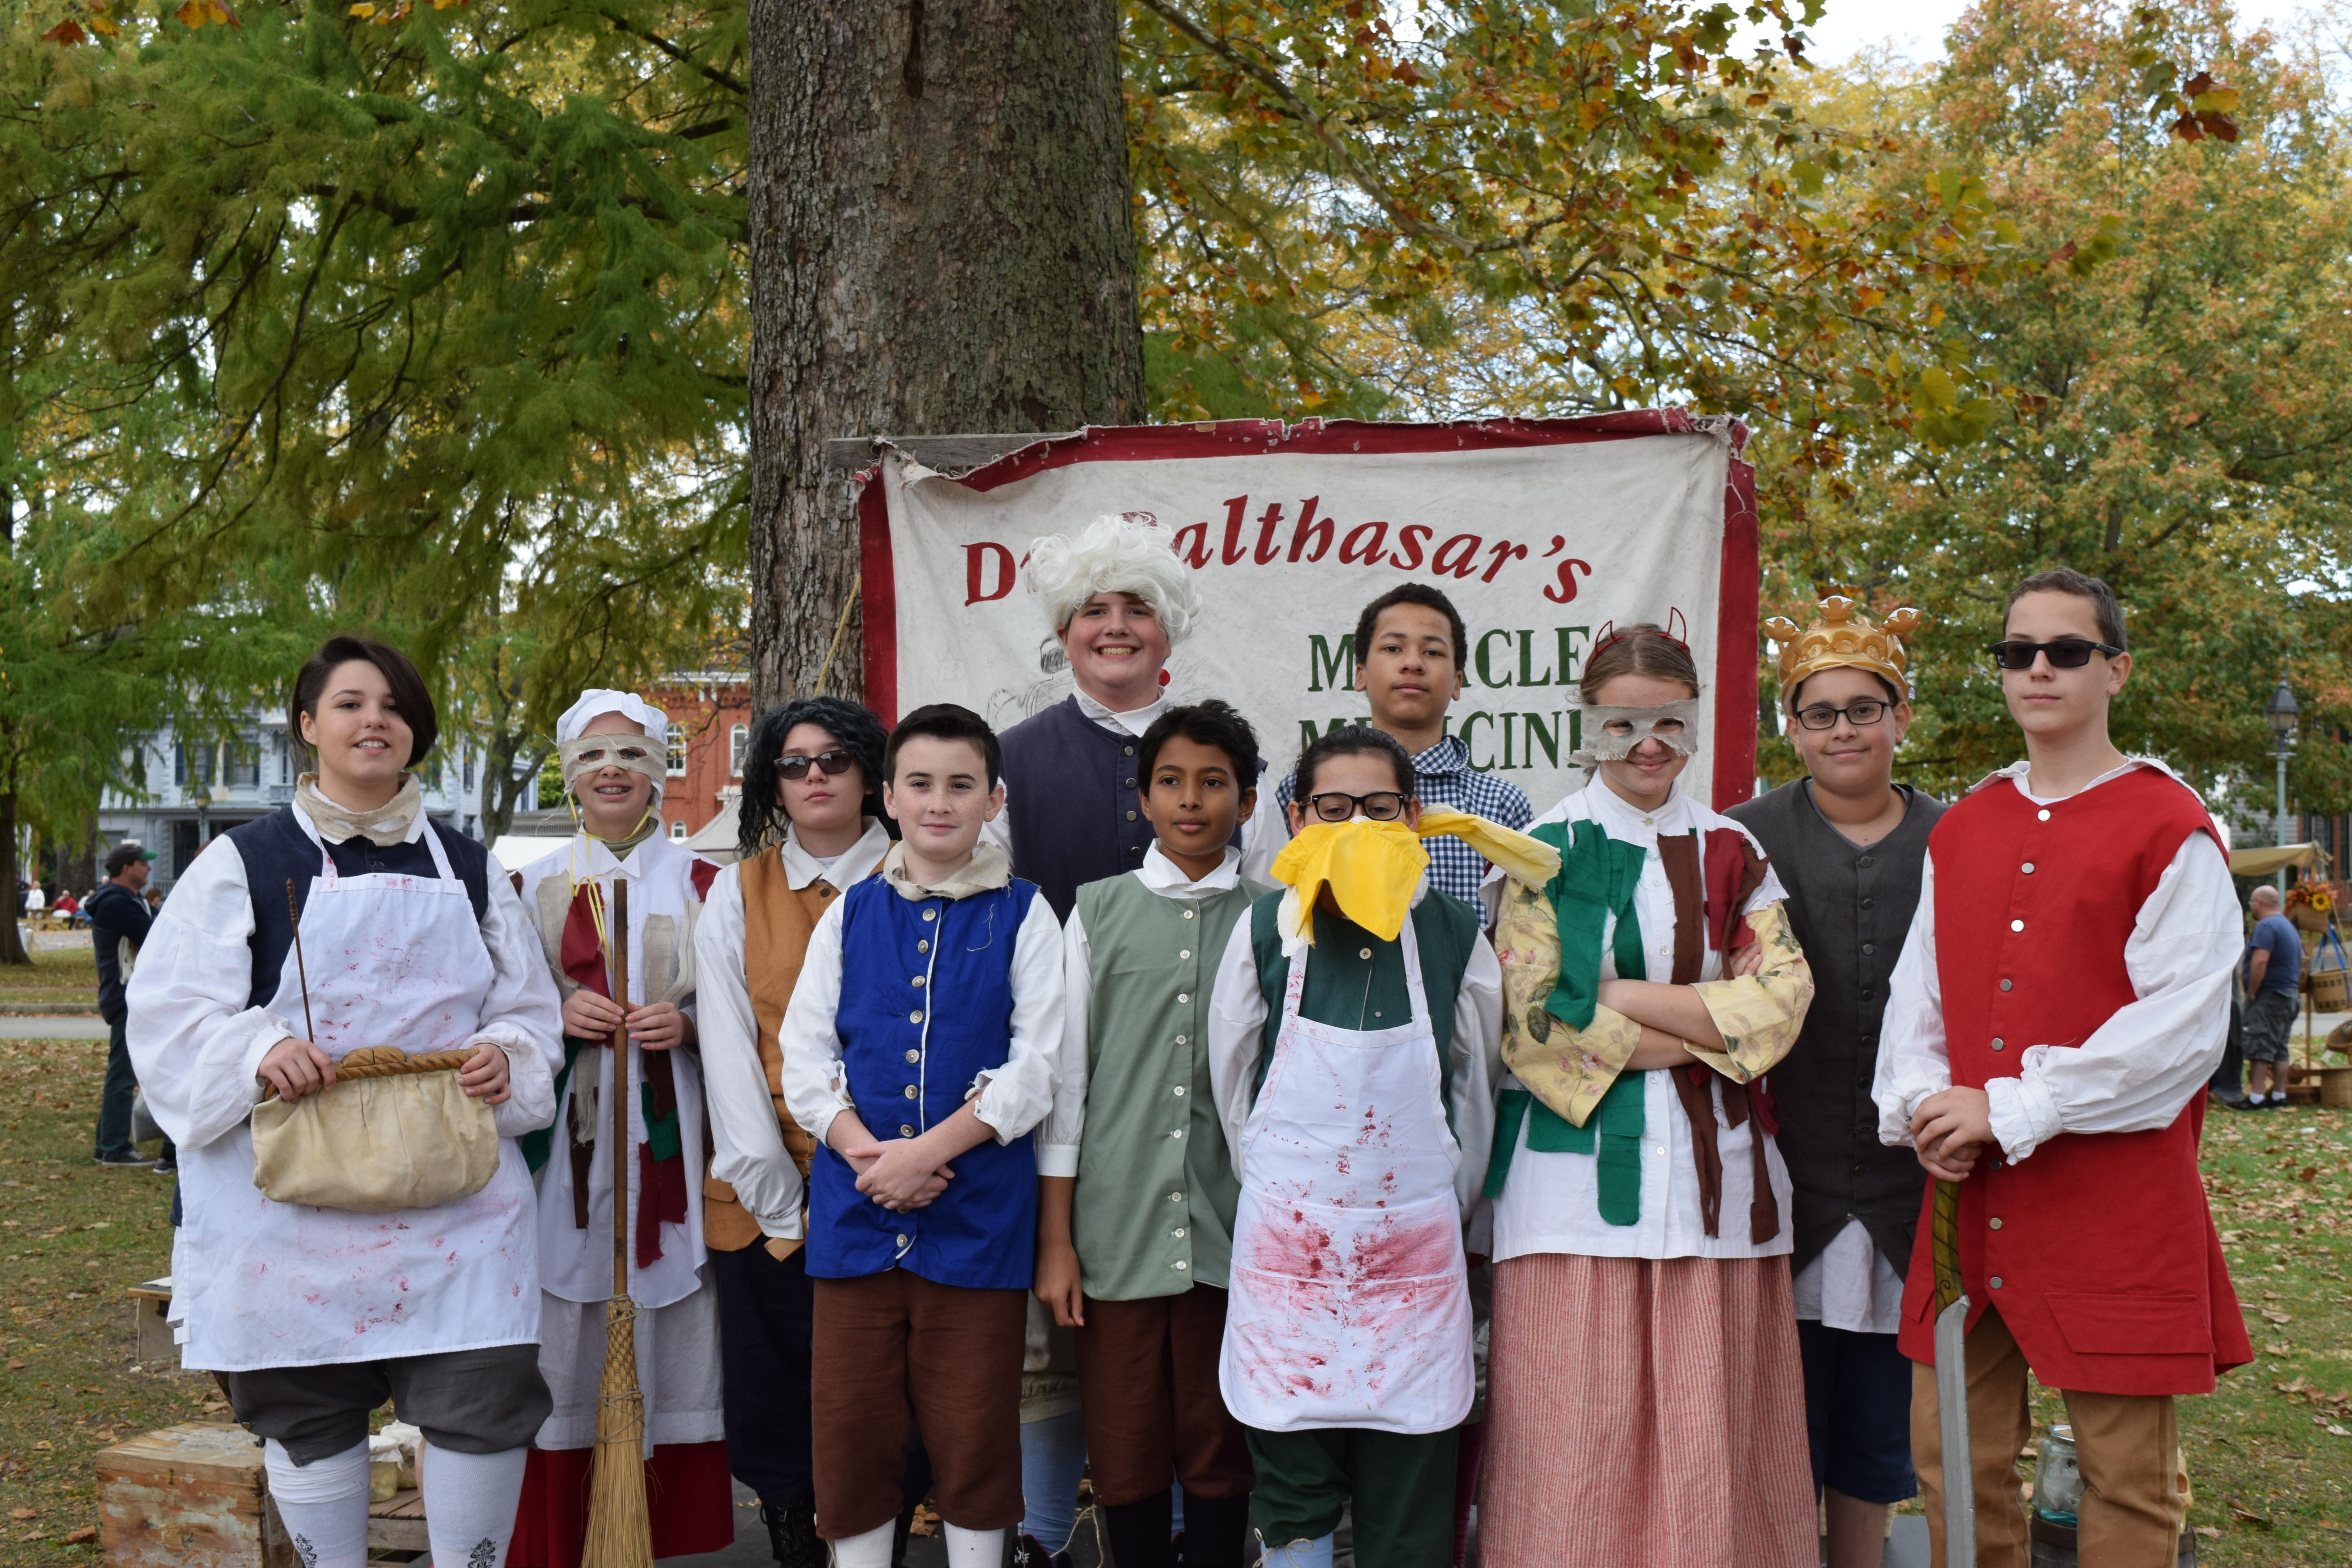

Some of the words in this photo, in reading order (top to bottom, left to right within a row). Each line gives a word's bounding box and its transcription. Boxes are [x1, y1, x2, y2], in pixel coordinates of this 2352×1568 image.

[961, 542, 1039, 606] D
[1119, 494, 1592, 604] althasar's
[1308, 626, 1590, 692] MCLE
